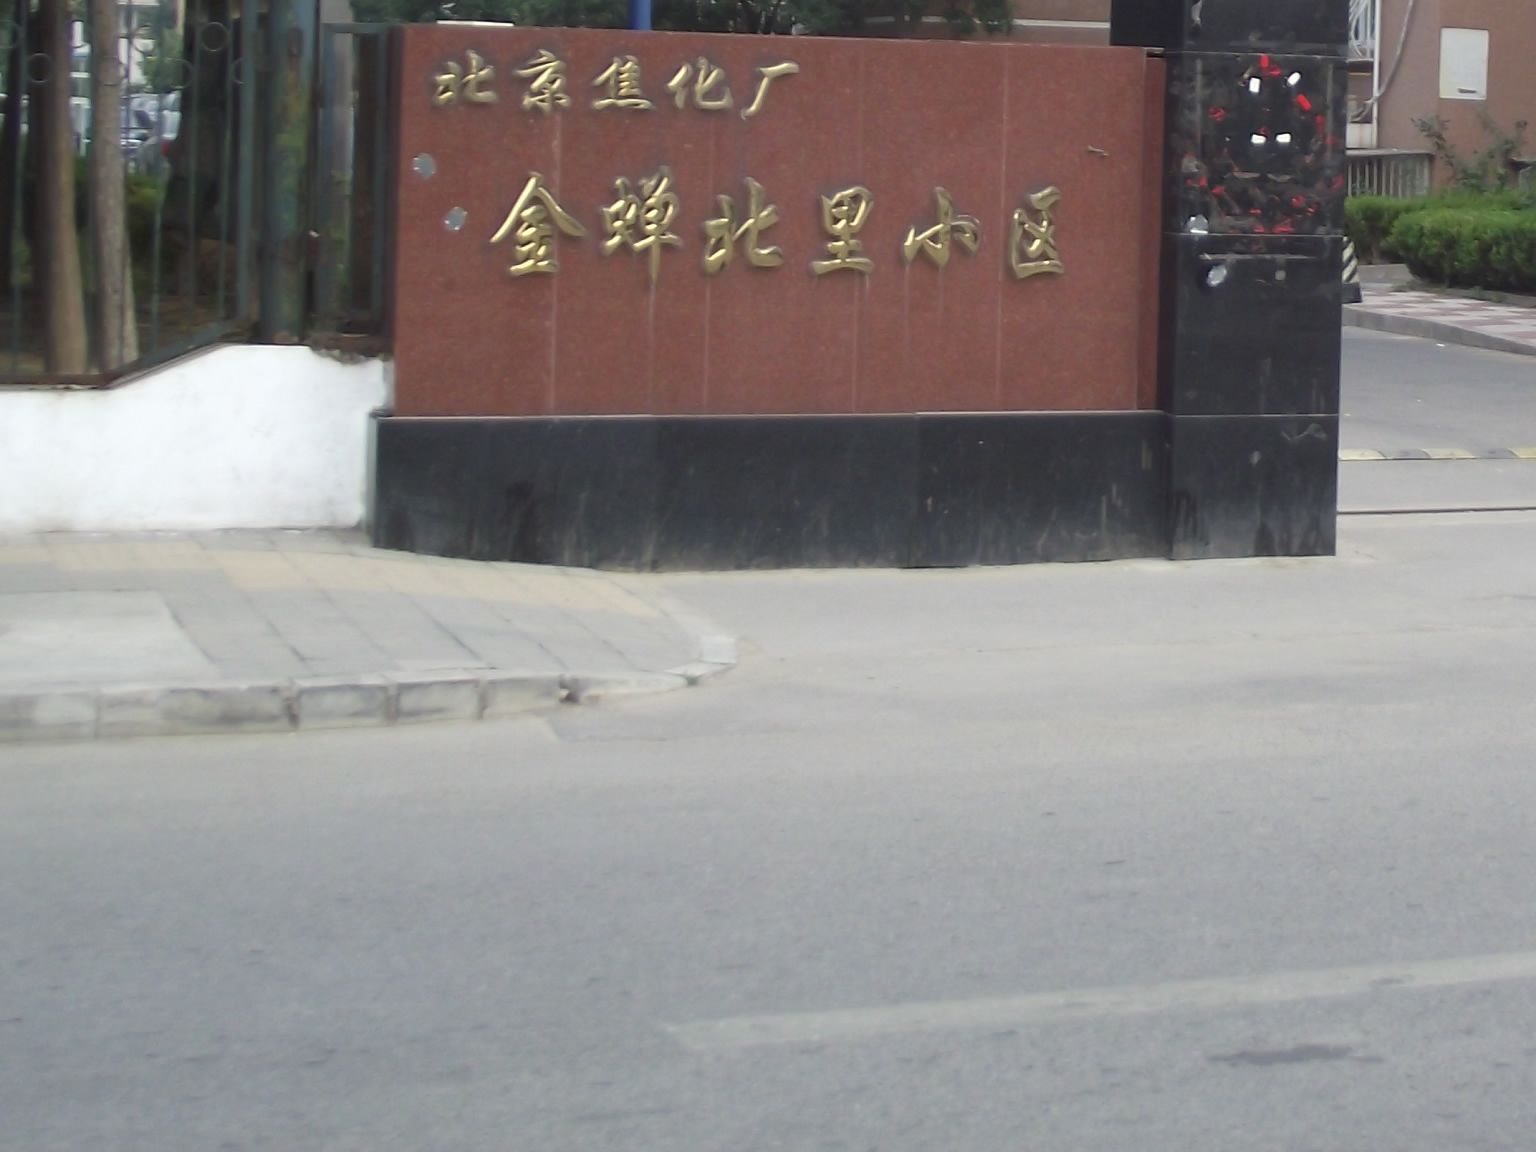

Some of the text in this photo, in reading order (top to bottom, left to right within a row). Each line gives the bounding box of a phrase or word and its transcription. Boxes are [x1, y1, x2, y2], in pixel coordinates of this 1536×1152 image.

[433, 49, 799, 121] 北京焦化厂
[490, 165, 1067, 284] 金蝉北里小区
